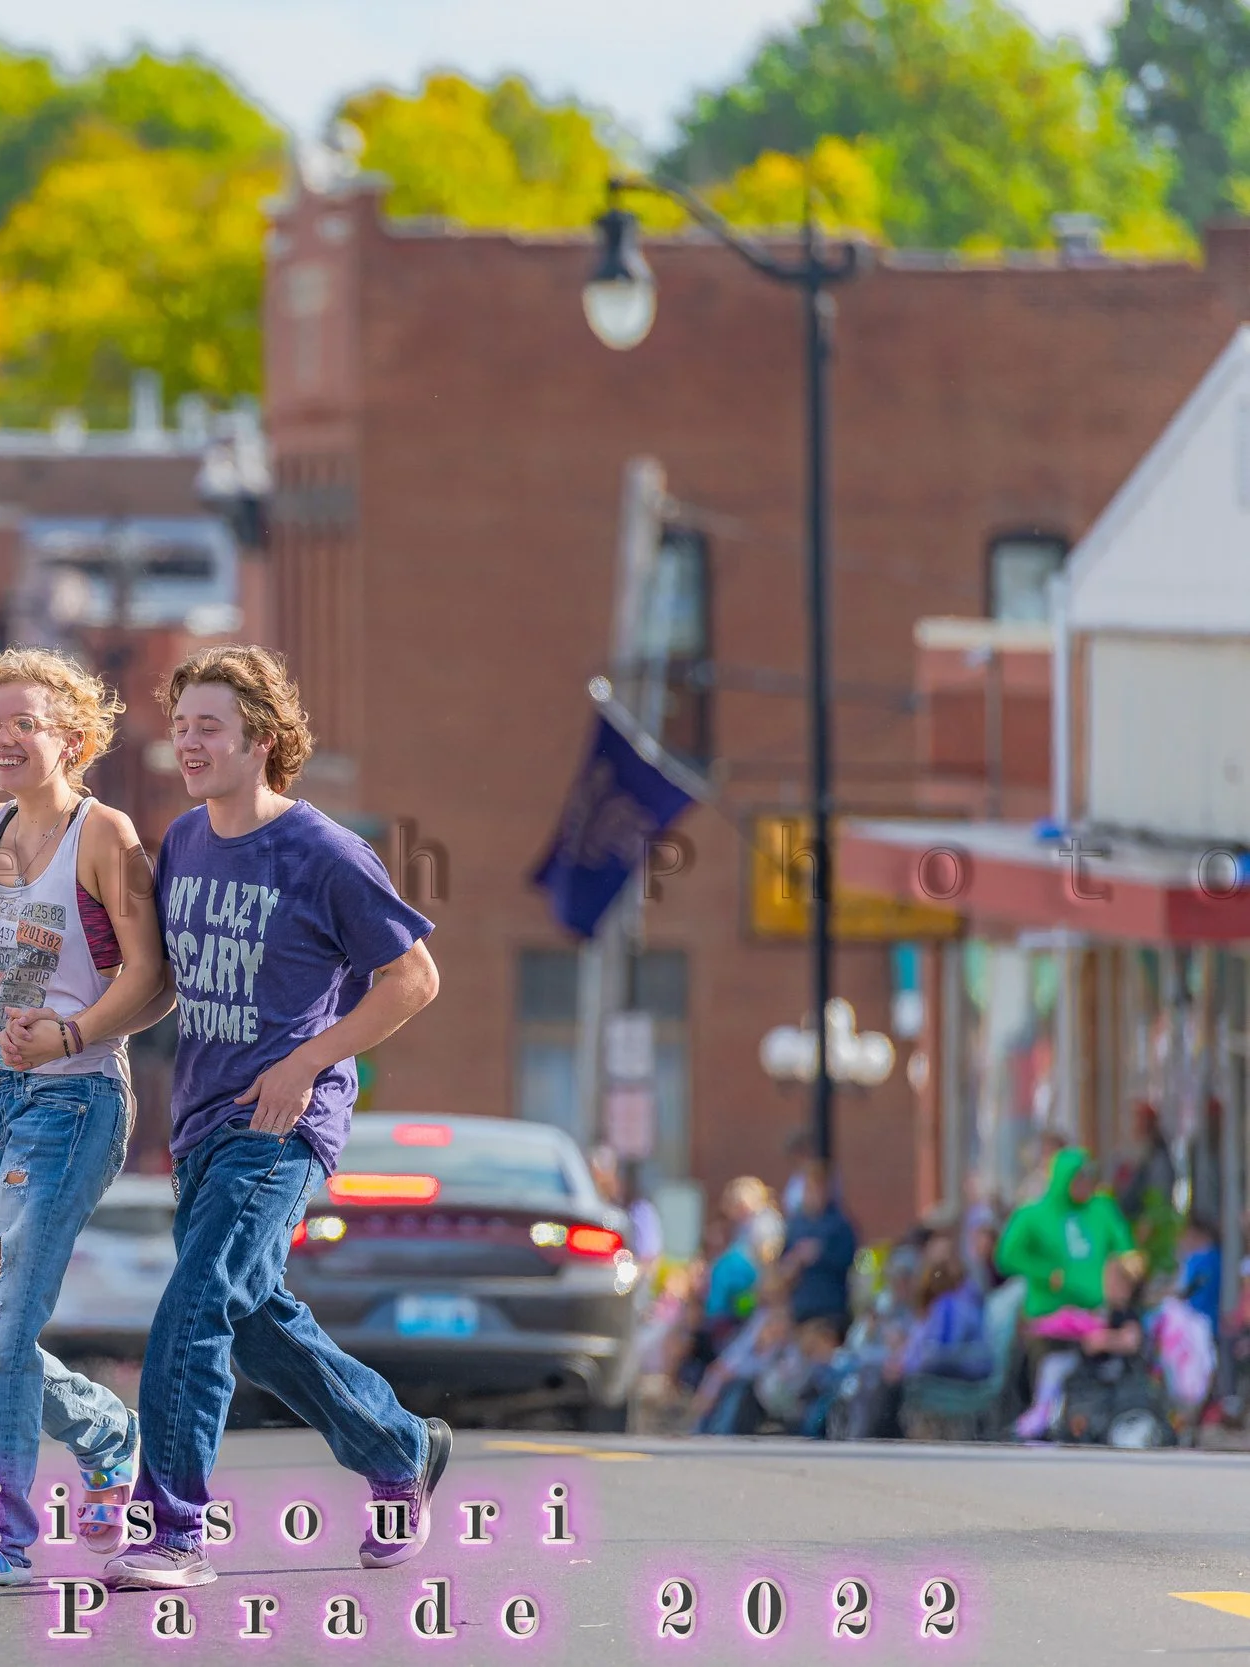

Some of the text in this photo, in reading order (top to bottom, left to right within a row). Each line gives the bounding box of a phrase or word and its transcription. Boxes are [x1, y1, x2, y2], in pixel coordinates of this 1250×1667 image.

[168, 876, 280, 939] MY LAZY
[166, 930, 264, 1003] SCARY
